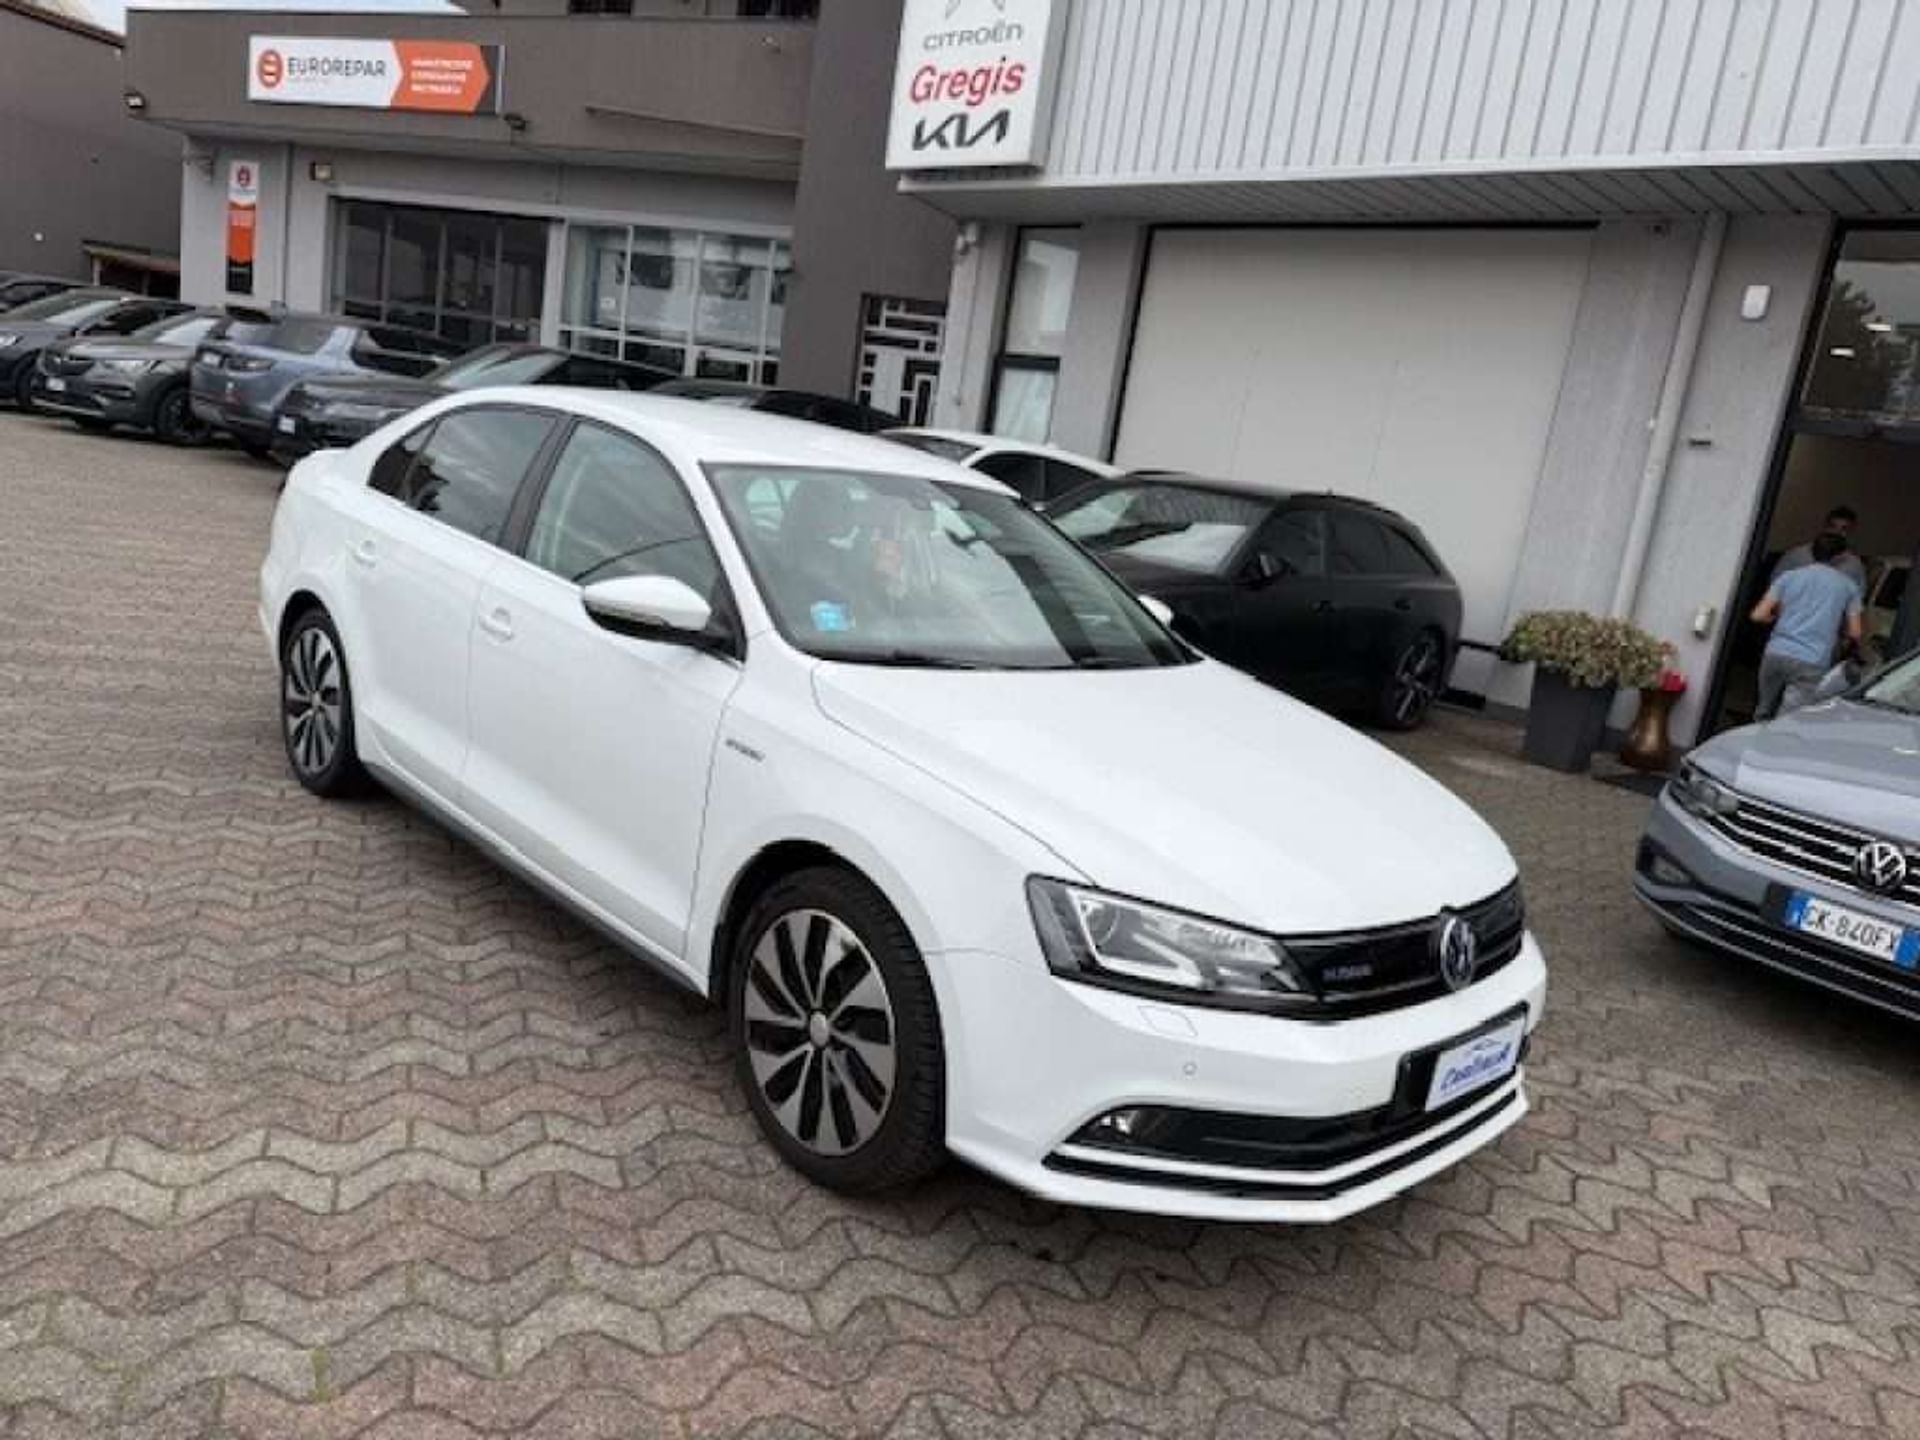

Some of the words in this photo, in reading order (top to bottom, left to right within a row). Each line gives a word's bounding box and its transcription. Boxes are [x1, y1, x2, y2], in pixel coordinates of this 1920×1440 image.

[287, 56, 386, 77] EUROREPAR
[910, 55, 1025, 106] Gregis
[911, 109, 1010, 151] KIA
